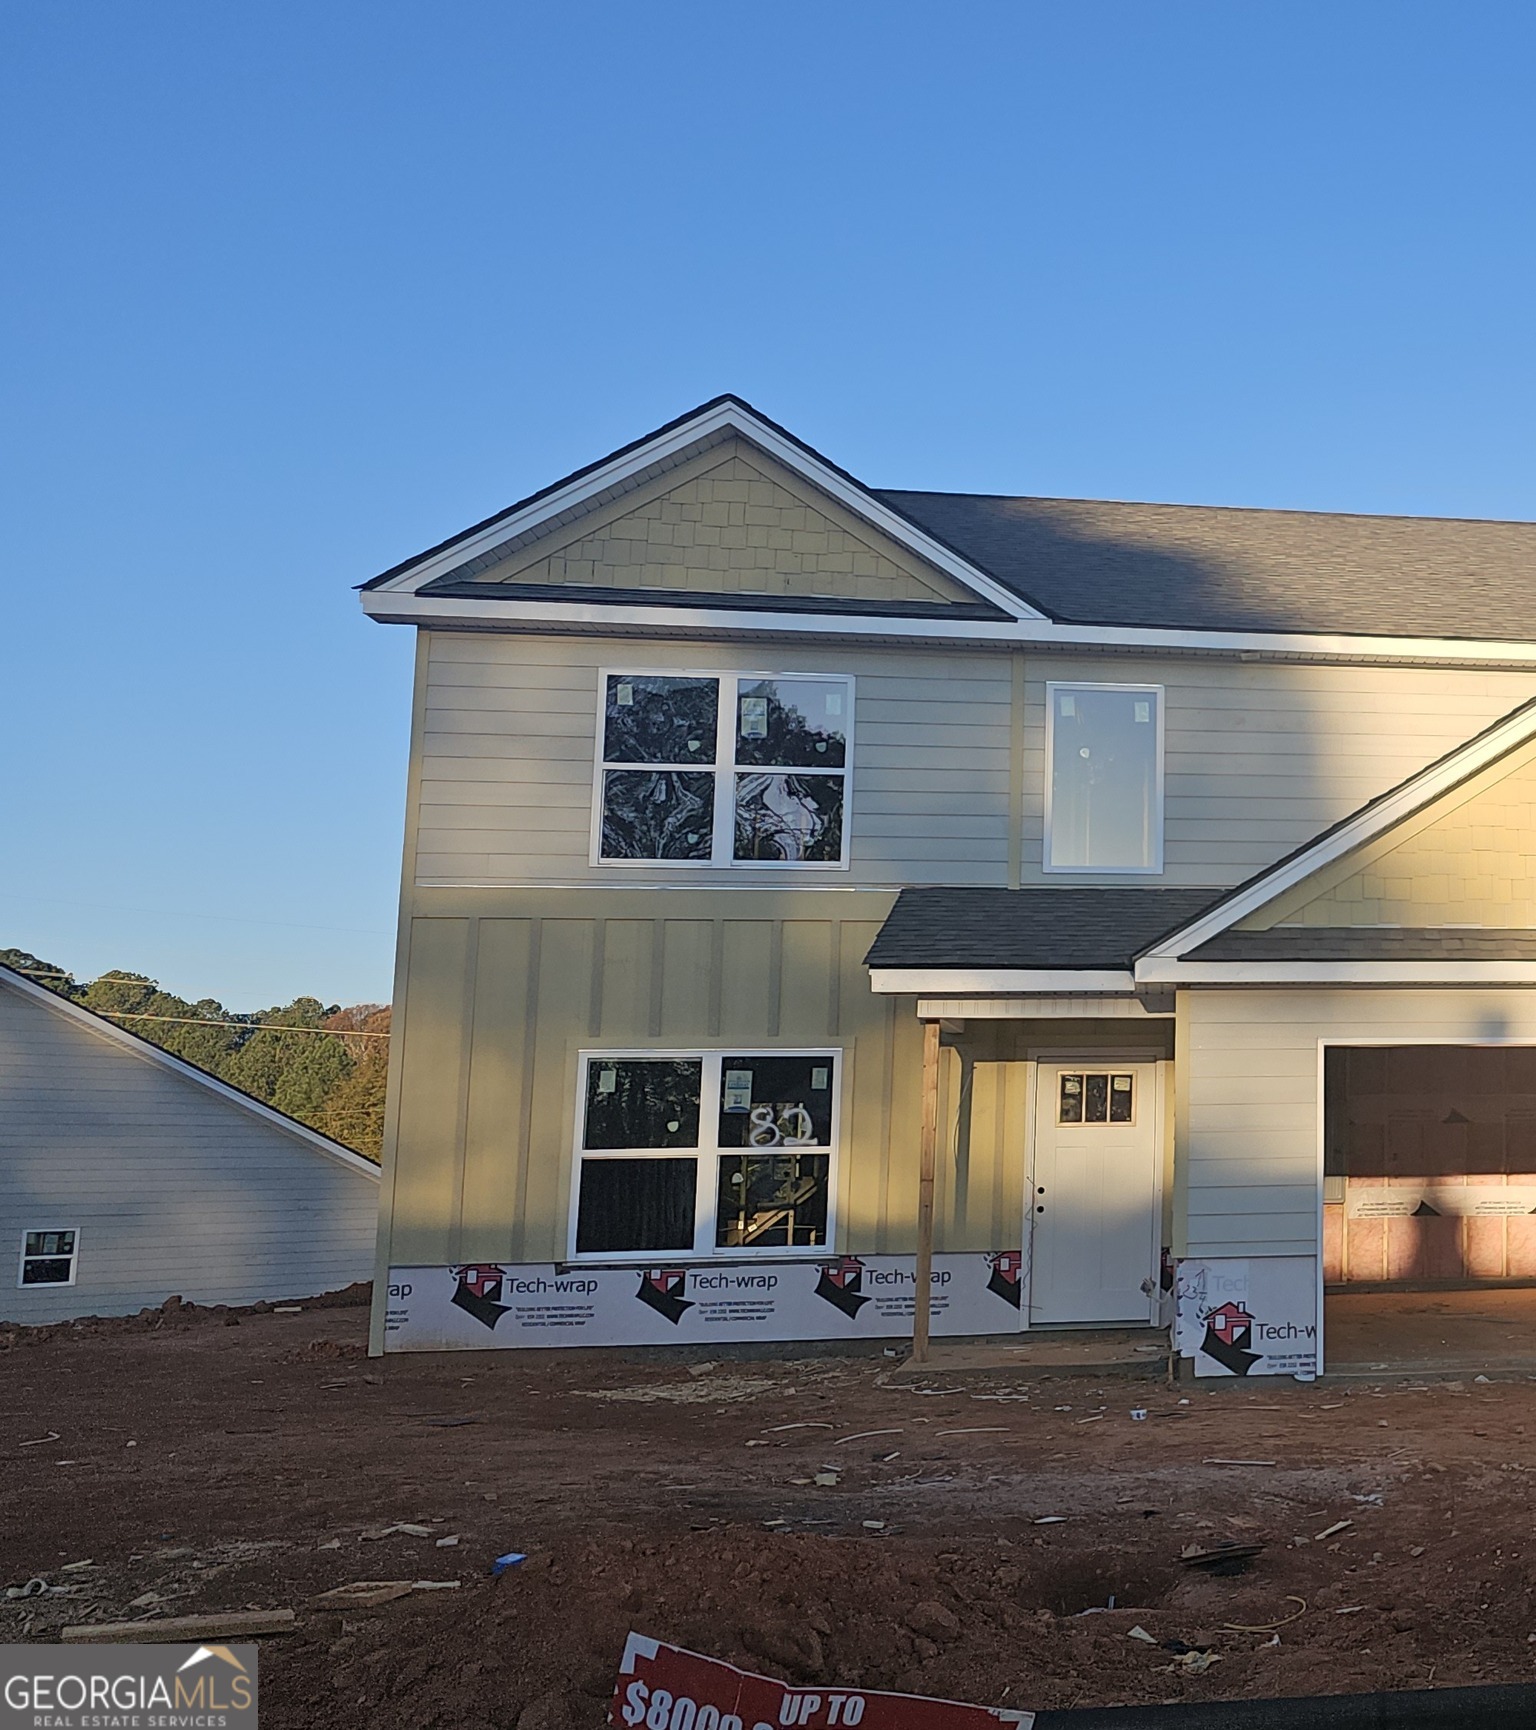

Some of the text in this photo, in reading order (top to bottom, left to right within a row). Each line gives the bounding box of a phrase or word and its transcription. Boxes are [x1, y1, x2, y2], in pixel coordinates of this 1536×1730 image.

[750, 1107, 818, 1147] 82
[506, 1277, 598, 1296] Tech-wrap
[689, 1273, 778, 1290] Tech-wrap
[779, 1693, 865, 1726] UP TO
